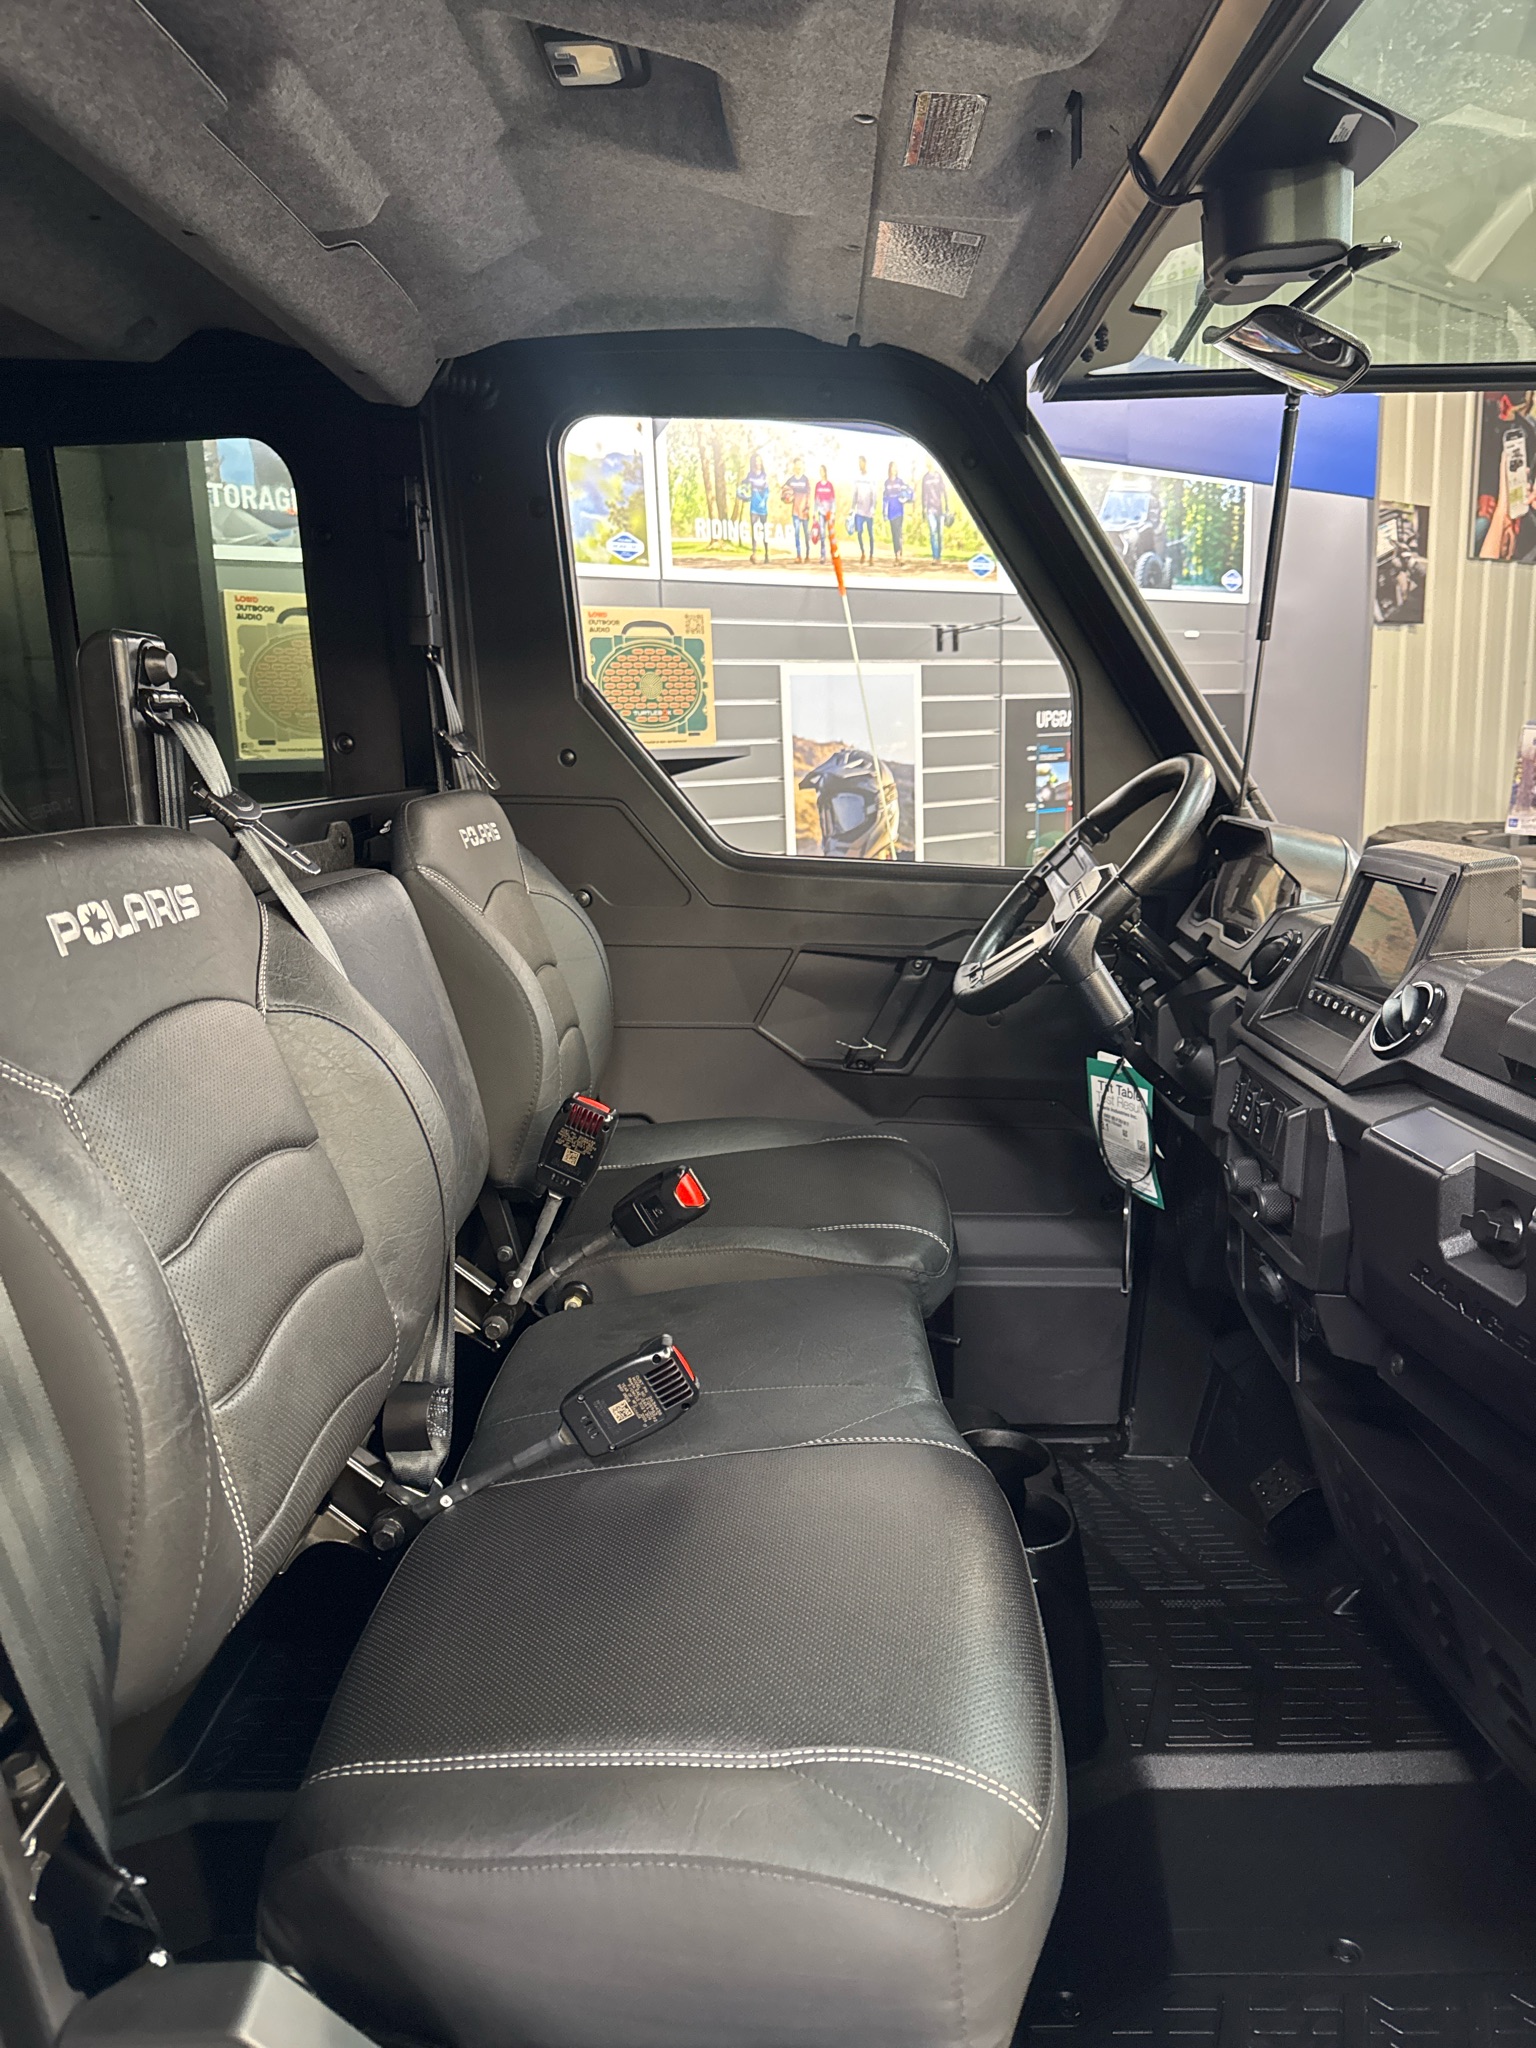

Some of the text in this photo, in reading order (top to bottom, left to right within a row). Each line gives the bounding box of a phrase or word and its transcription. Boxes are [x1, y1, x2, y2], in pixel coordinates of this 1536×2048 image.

[207, 482, 298, 513] TORAG
[695, 517, 750, 541] RIDING
[236, 613, 263, 621] AUDIO
[458, 822, 501, 849] POLARIS
[46, 883, 200, 958] POLARIS
[1096, 1091, 1115, 1106] Tst
[1097, 1080, 1114, 1094] Tt
